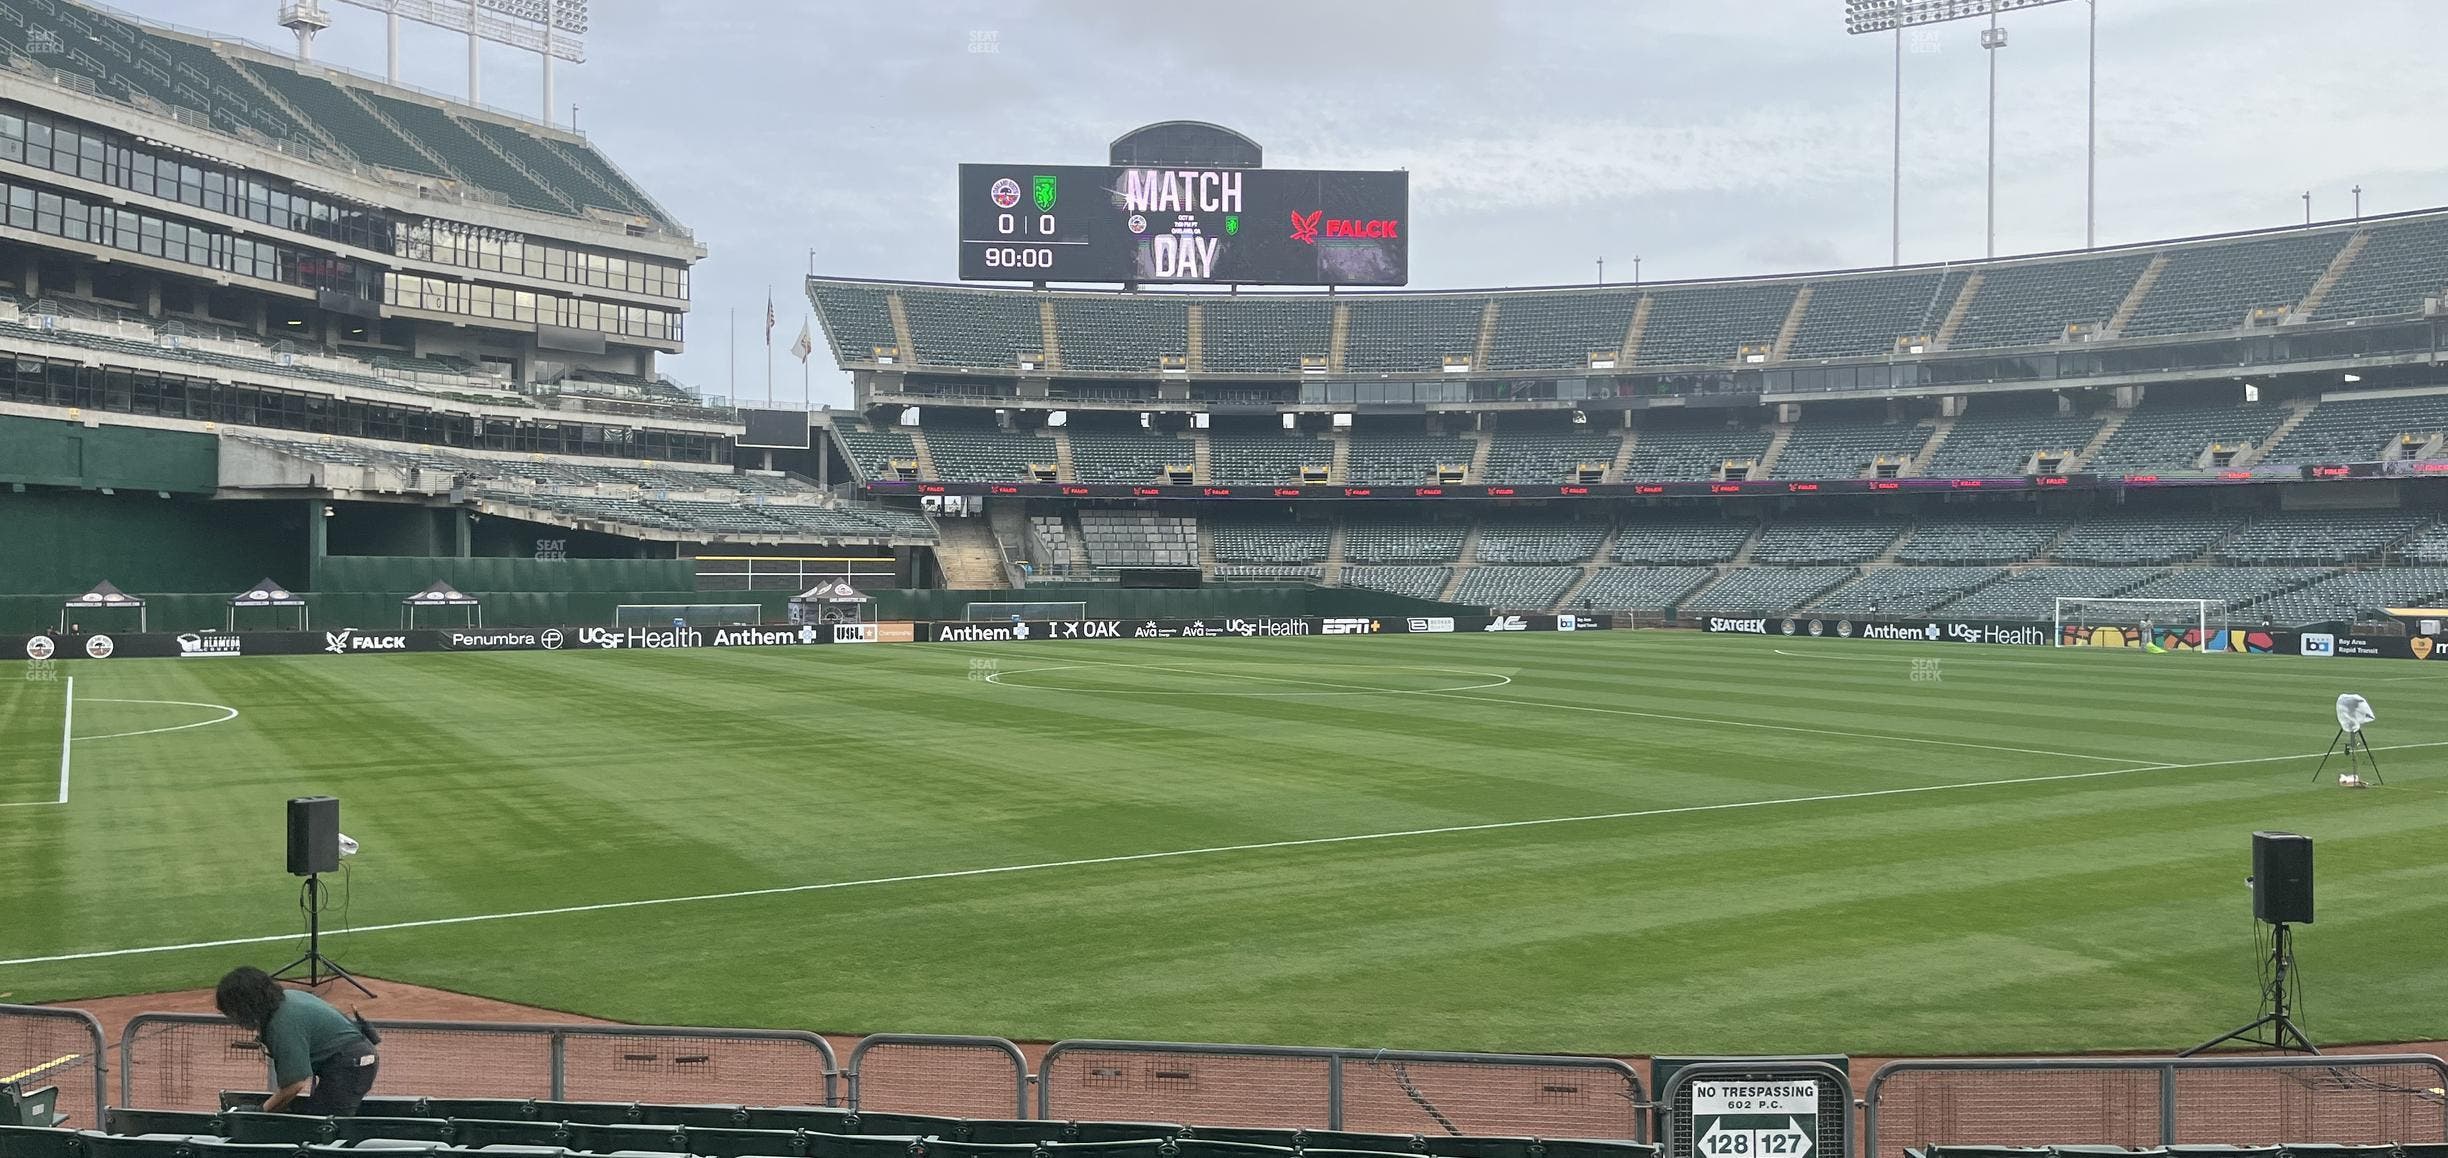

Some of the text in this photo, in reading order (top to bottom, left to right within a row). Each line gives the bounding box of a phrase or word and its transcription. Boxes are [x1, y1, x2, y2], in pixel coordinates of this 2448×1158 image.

[1127, 170, 1242, 212] MATCH
[998, 213, 1055, 235] 0 0
[1326, 219, 1398, 238] FALCK
[985, 248, 1052, 268] 90:00
[1154, 235, 1218, 278] DAY
[939, 624, 1010, 641] Anthem
[1049, 621, 1121, 638] I OAK
[1134, 626, 1157, 637] Ava
[1182, 626, 1204, 636] Ava
[1226, 618, 1309, 637] UCSF Health
[1710, 617, 1766, 634] SEATGEEK
[1863, 623, 1922, 640] Anthem
[1948, 623, 2044, 645] UCSF Health
[352, 636, 406, 649] FALCK
[452, 633, 535, 645] Penumbra
[579, 626, 702, 649] UCSF Health
[714, 628, 794, 646] Anthem
[1697, 1086, 1814, 1098] NO TRESPASSING
[1727, 1101, 1783, 1109] 602 P.C.
[1706, 1134, 1802, 1154] 128 127
